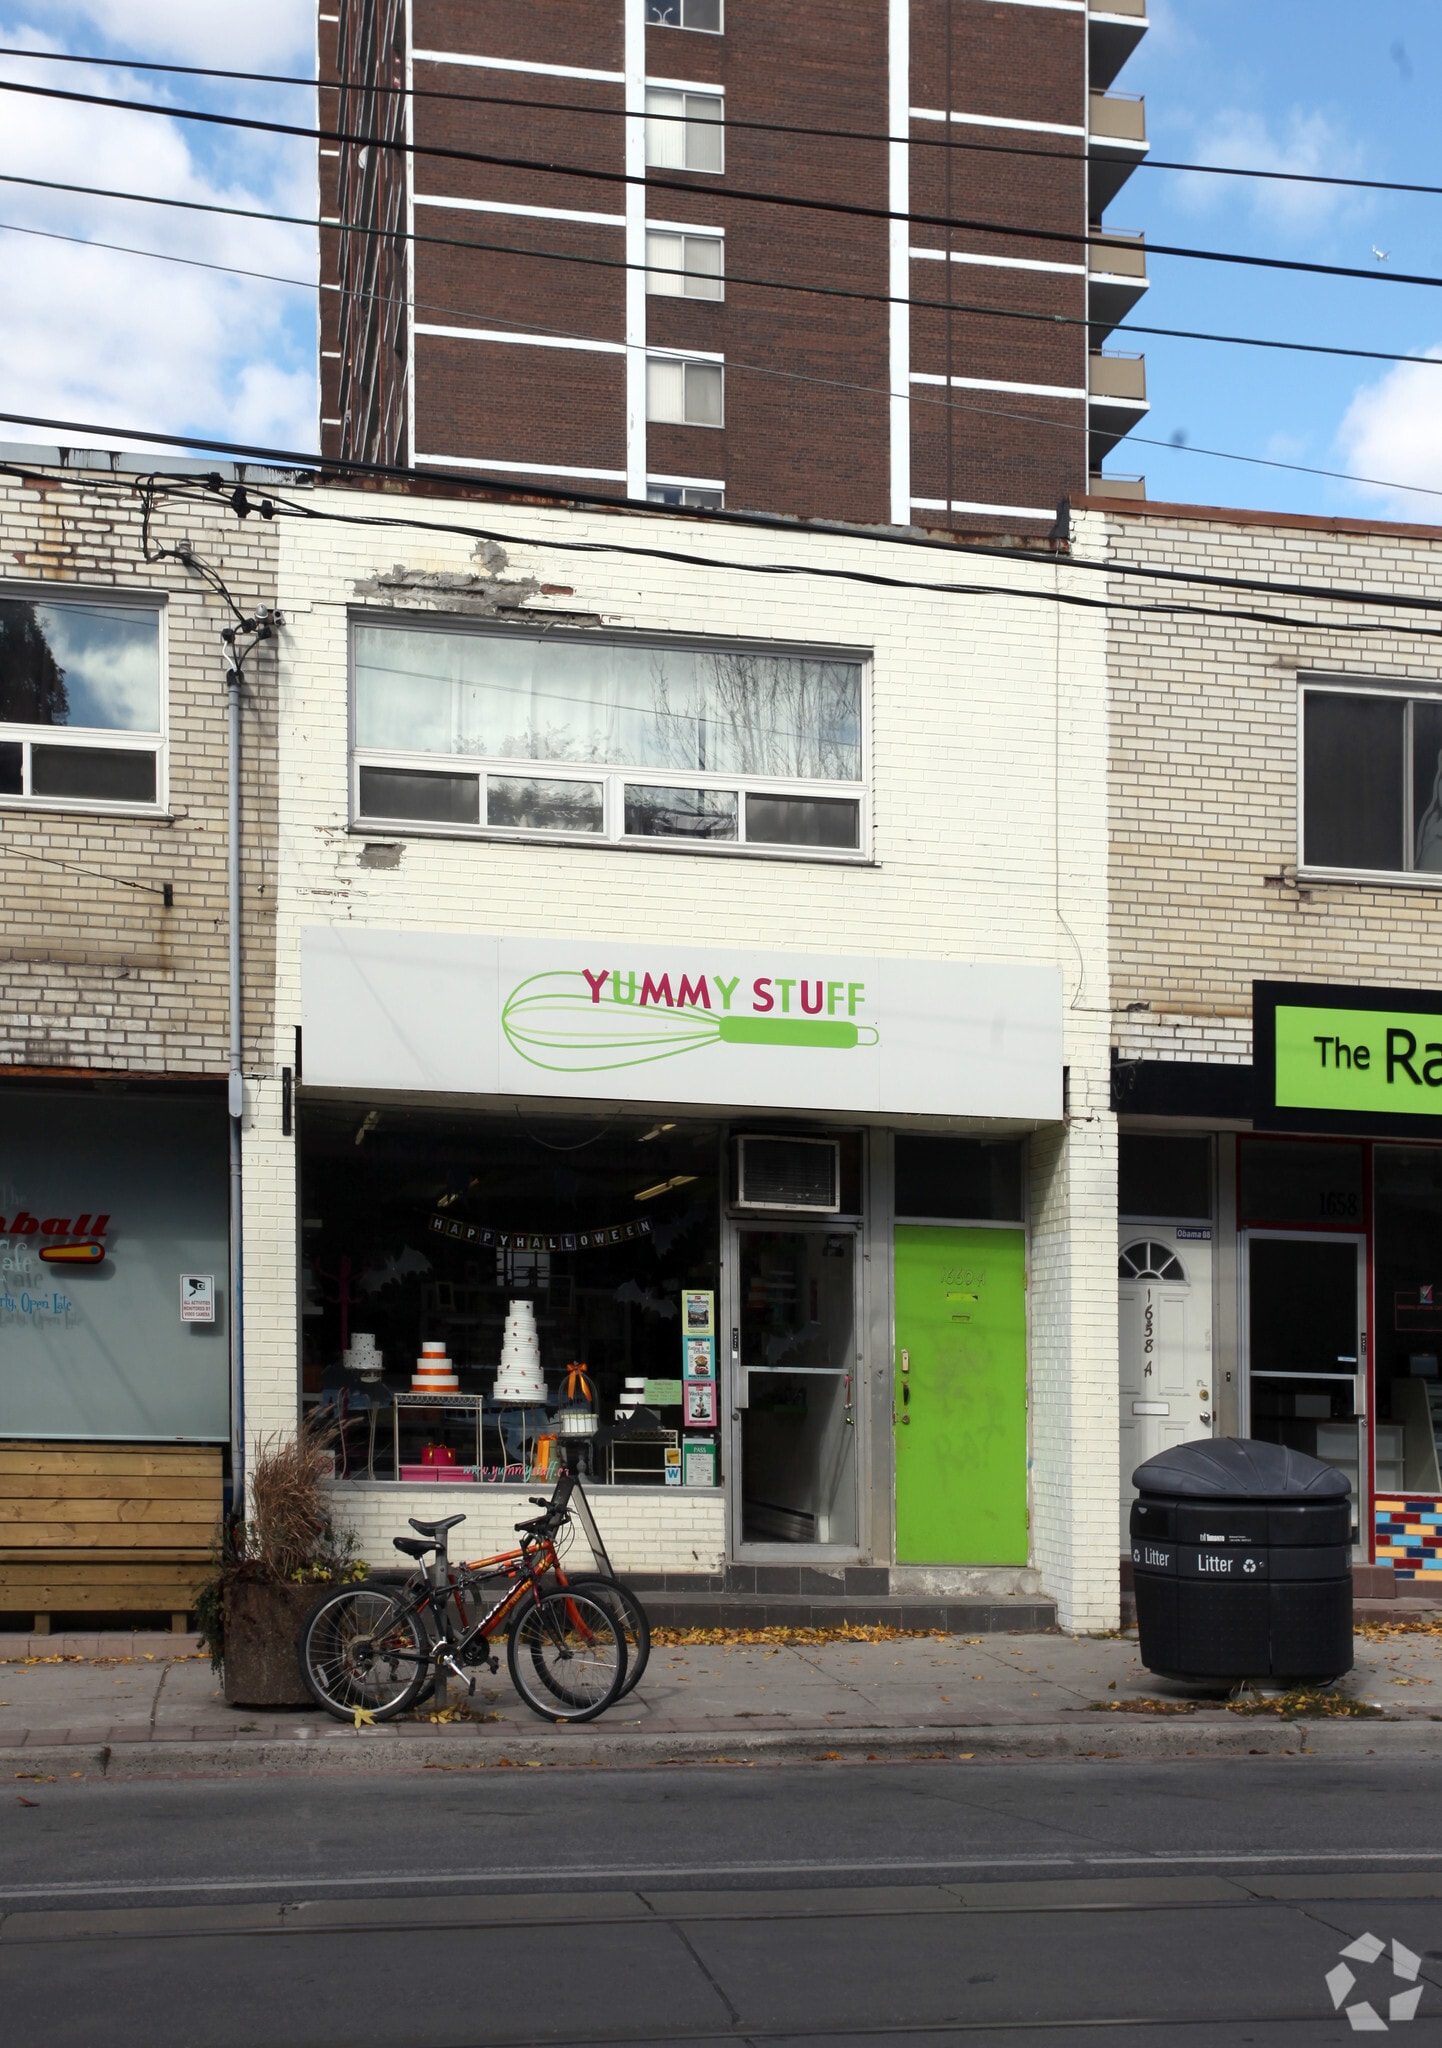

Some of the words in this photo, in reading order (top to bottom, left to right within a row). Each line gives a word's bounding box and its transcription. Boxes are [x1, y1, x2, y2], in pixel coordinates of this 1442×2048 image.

[581, 968, 741, 1010] YUMMY
[752, 977, 866, 1017] STUFF
[1313, 1036, 1371, 1070] The
[1319, 1191, 1358, 1217] 1658
[0, 1211, 111, 1237] ball
[1177, 1229, 1202, 1239] Obama
[21, 1292, 49, 1315] Open
[53, 1292, 72, 1314] Late
[693, 1446, 707, 1454] PASS
[667, 1468, 679, 1479] W
[1145, 1546, 1170, 1567] Litter
[1198, 1553, 1234, 1573] Litter
